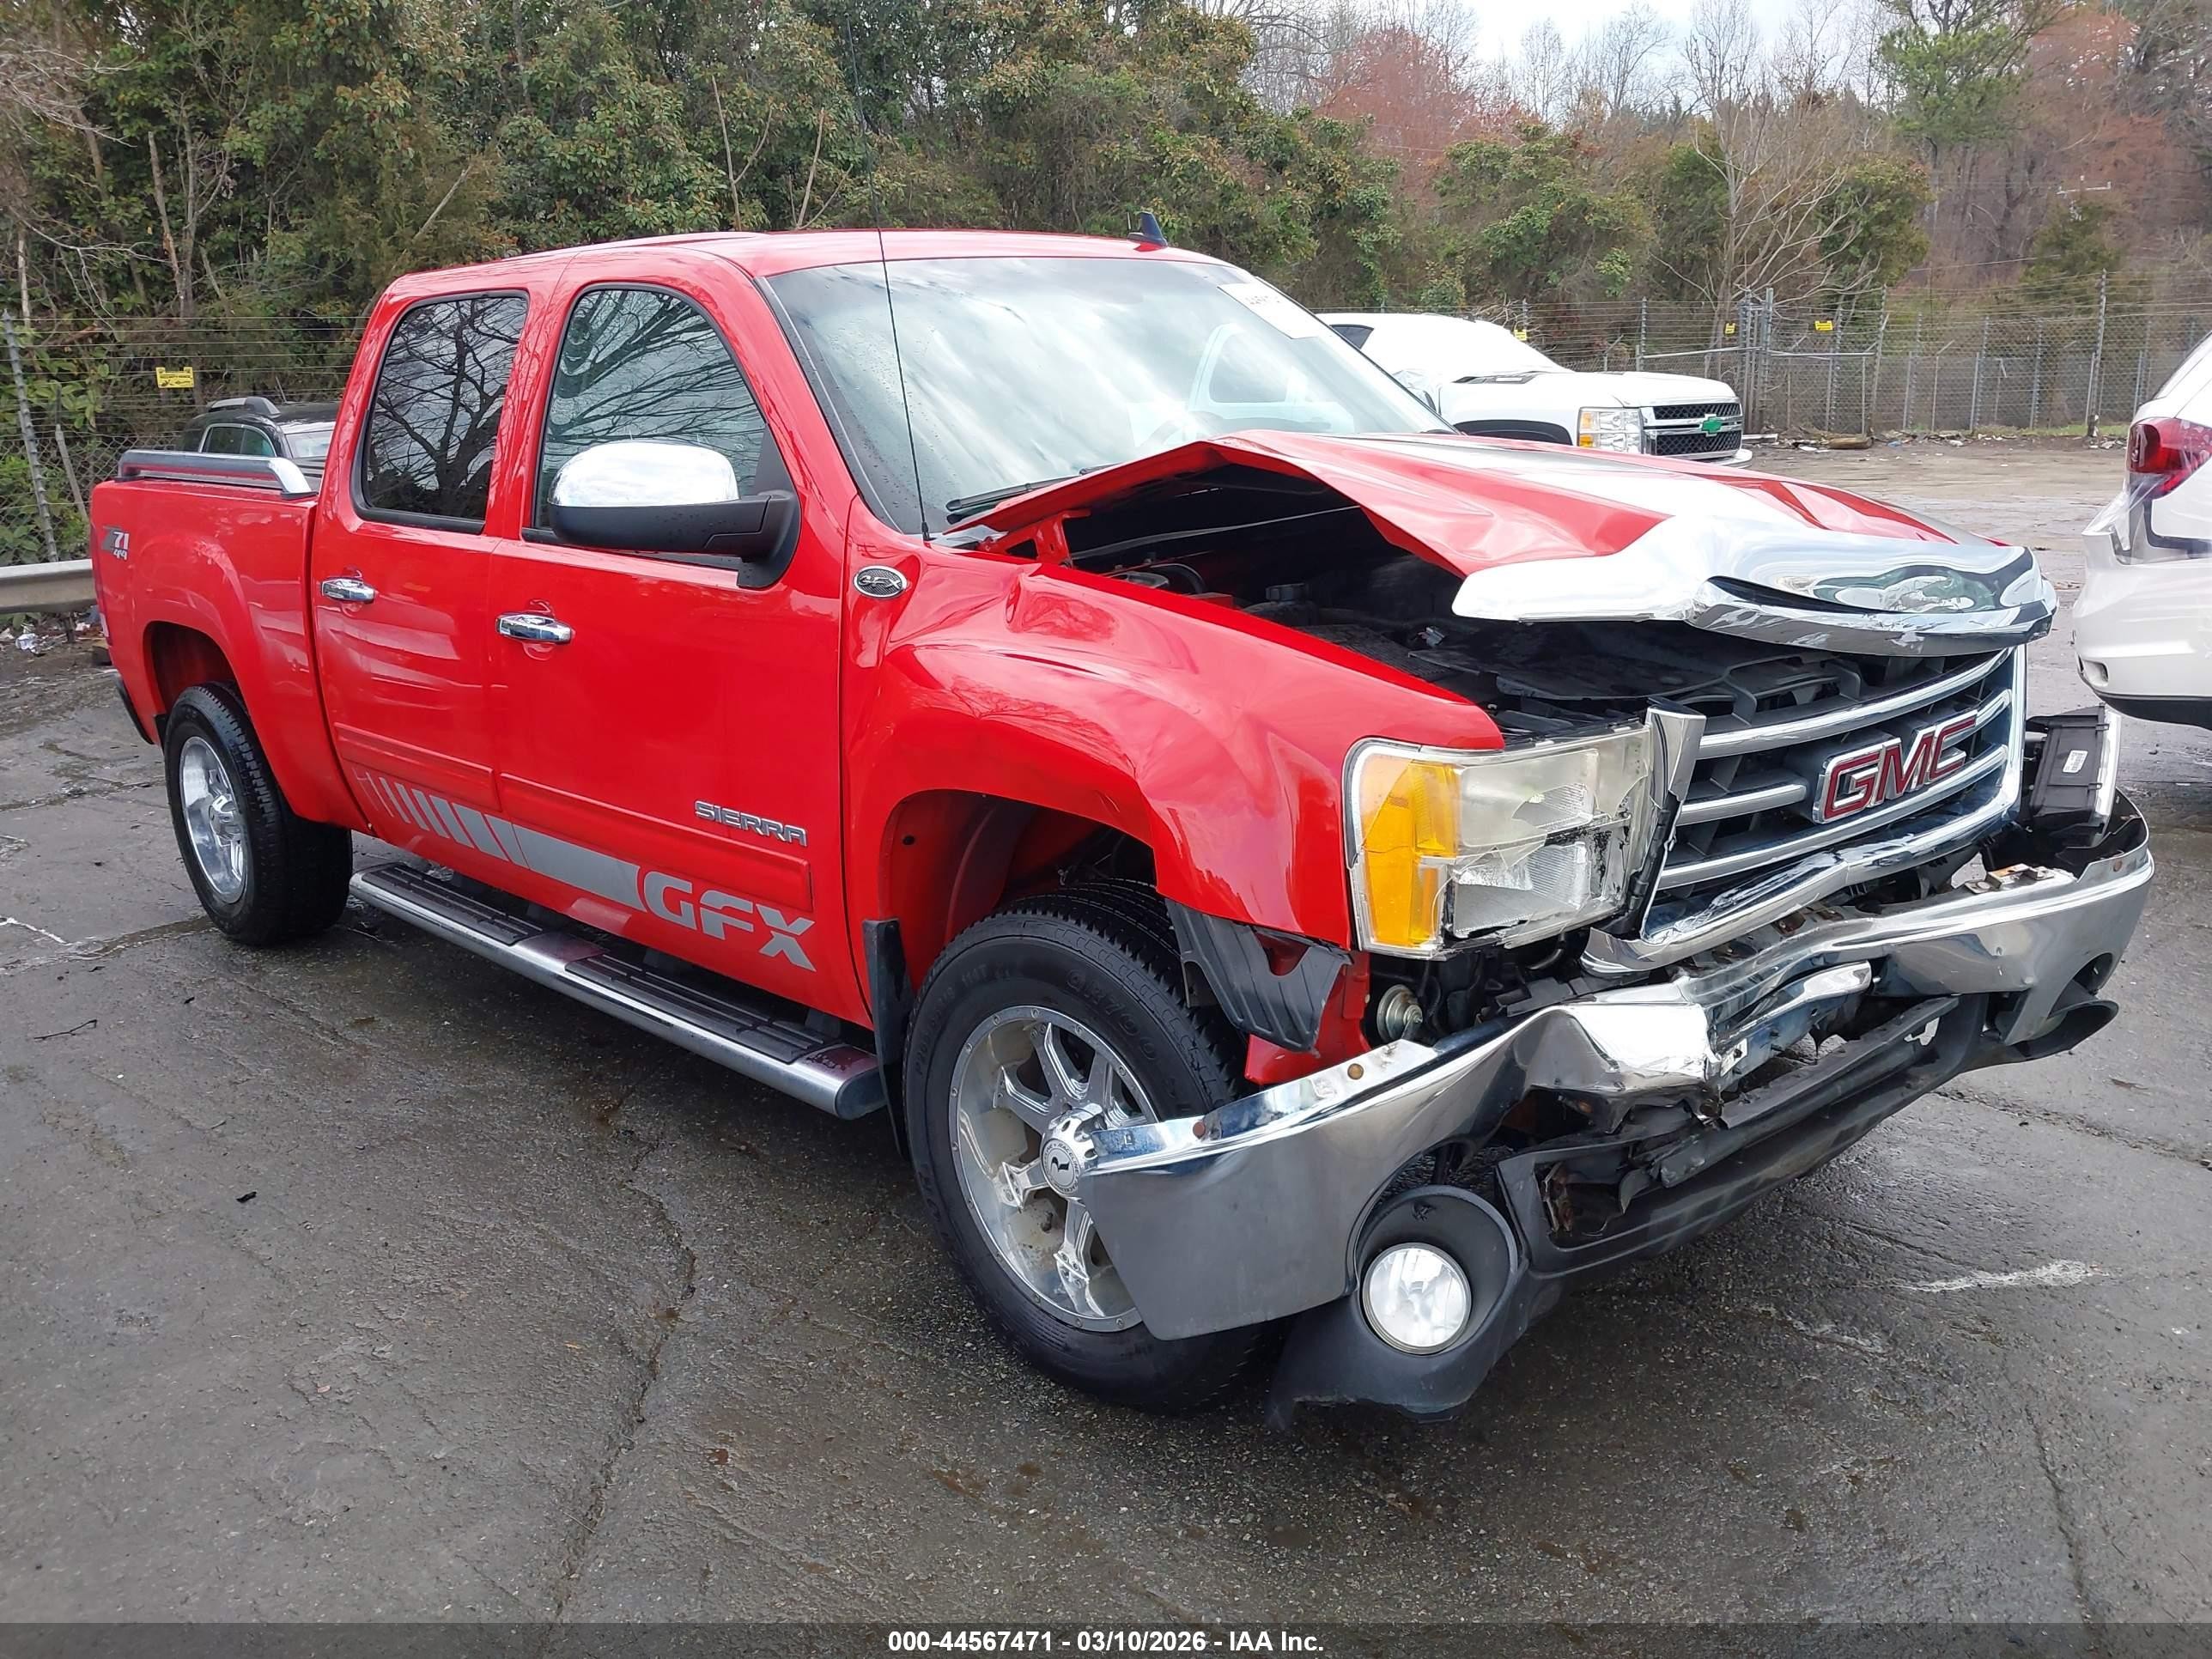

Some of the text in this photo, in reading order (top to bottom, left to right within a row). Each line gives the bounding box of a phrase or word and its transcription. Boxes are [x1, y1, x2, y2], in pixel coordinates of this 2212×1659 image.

[1814, 709, 1978, 824] GMC
[694, 799, 808, 847] SIERRA
[643, 871, 817, 972] GFX
